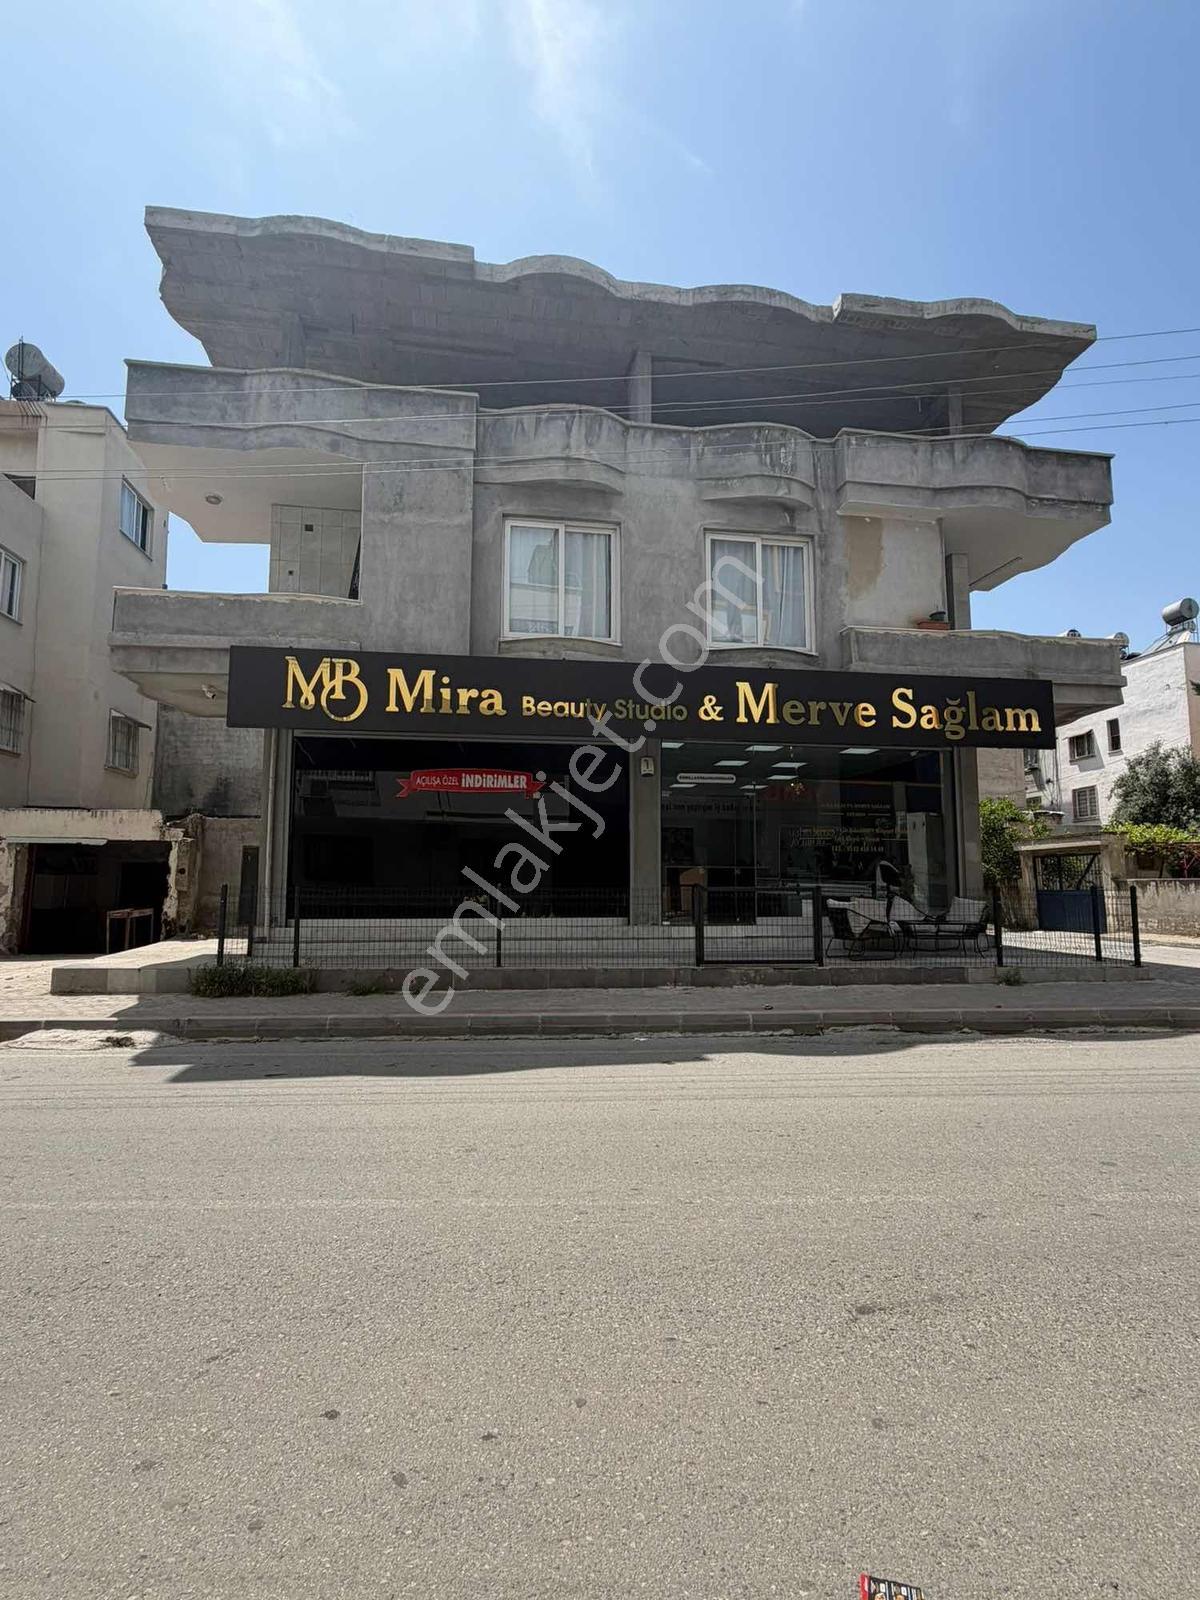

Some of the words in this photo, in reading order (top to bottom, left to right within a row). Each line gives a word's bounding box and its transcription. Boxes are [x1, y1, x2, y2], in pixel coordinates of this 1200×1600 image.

[385, 667, 507, 716] Mira
[521, 695, 607, 721] Beauty
[614, 697, 688, 722] Studio
[698, 694, 724, 722] &
[735, 681, 877, 728] Merve
[891, 687, 1042, 741] Sağlam
[443, 775, 459, 786] ÖZEL
[461, 773, 527, 789] İNDİRİMLER
